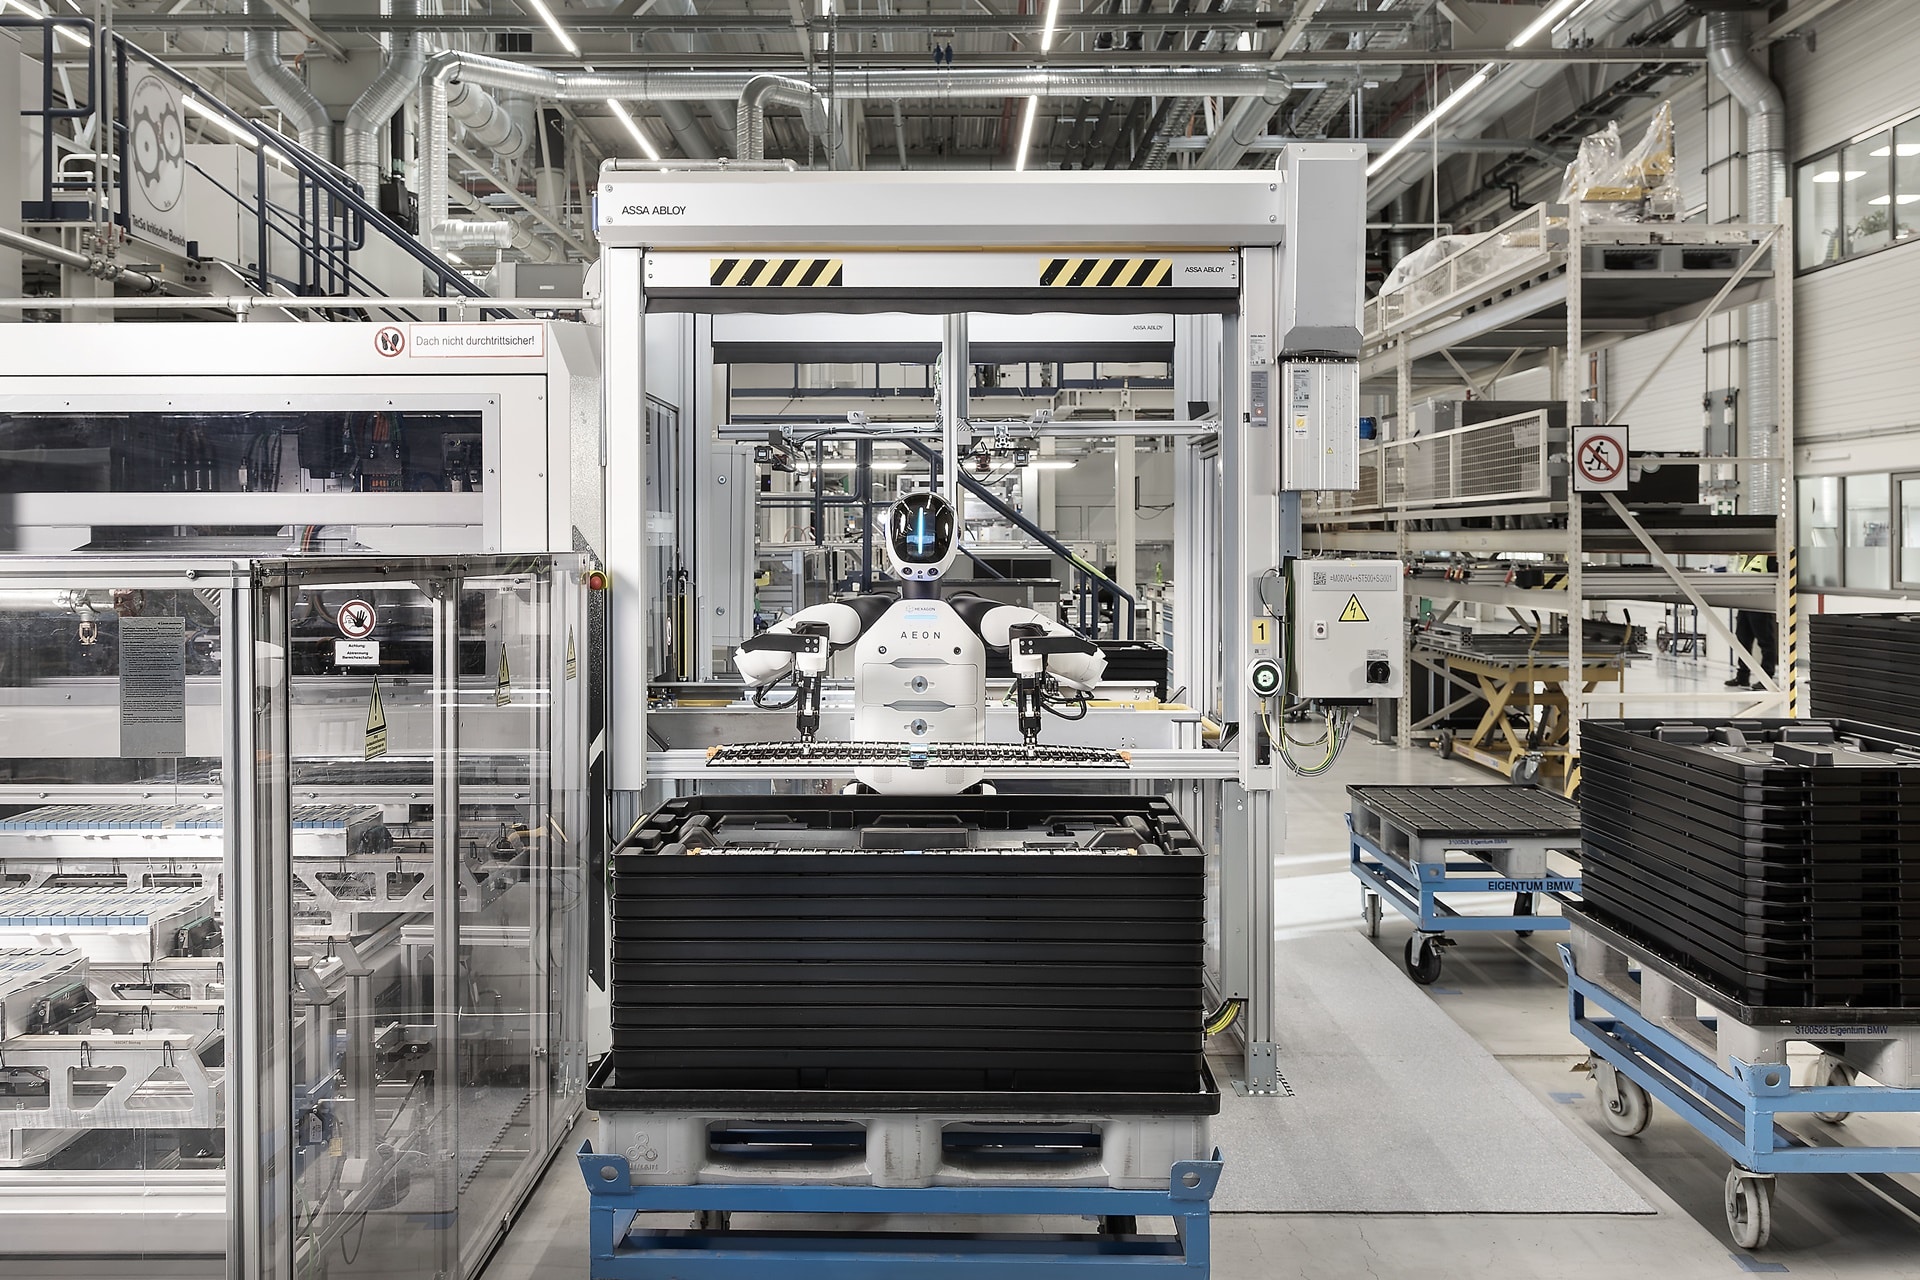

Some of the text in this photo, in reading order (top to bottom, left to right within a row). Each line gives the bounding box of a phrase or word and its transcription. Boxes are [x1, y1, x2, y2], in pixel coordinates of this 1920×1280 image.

[621, 205, 686, 215] ASSA ABLOY
[168, 228, 186, 247] Bereich
[416, 335, 535, 346] Dach nicht durchtrittsicher!
[900, 631, 941, 639] AEON
[1257, 622, 1265, 641] 1
[1488, 881, 1574, 891] EIGENTUM BMW
[1795, 1025, 1888, 1036] 3100528 Eigentum BMW
